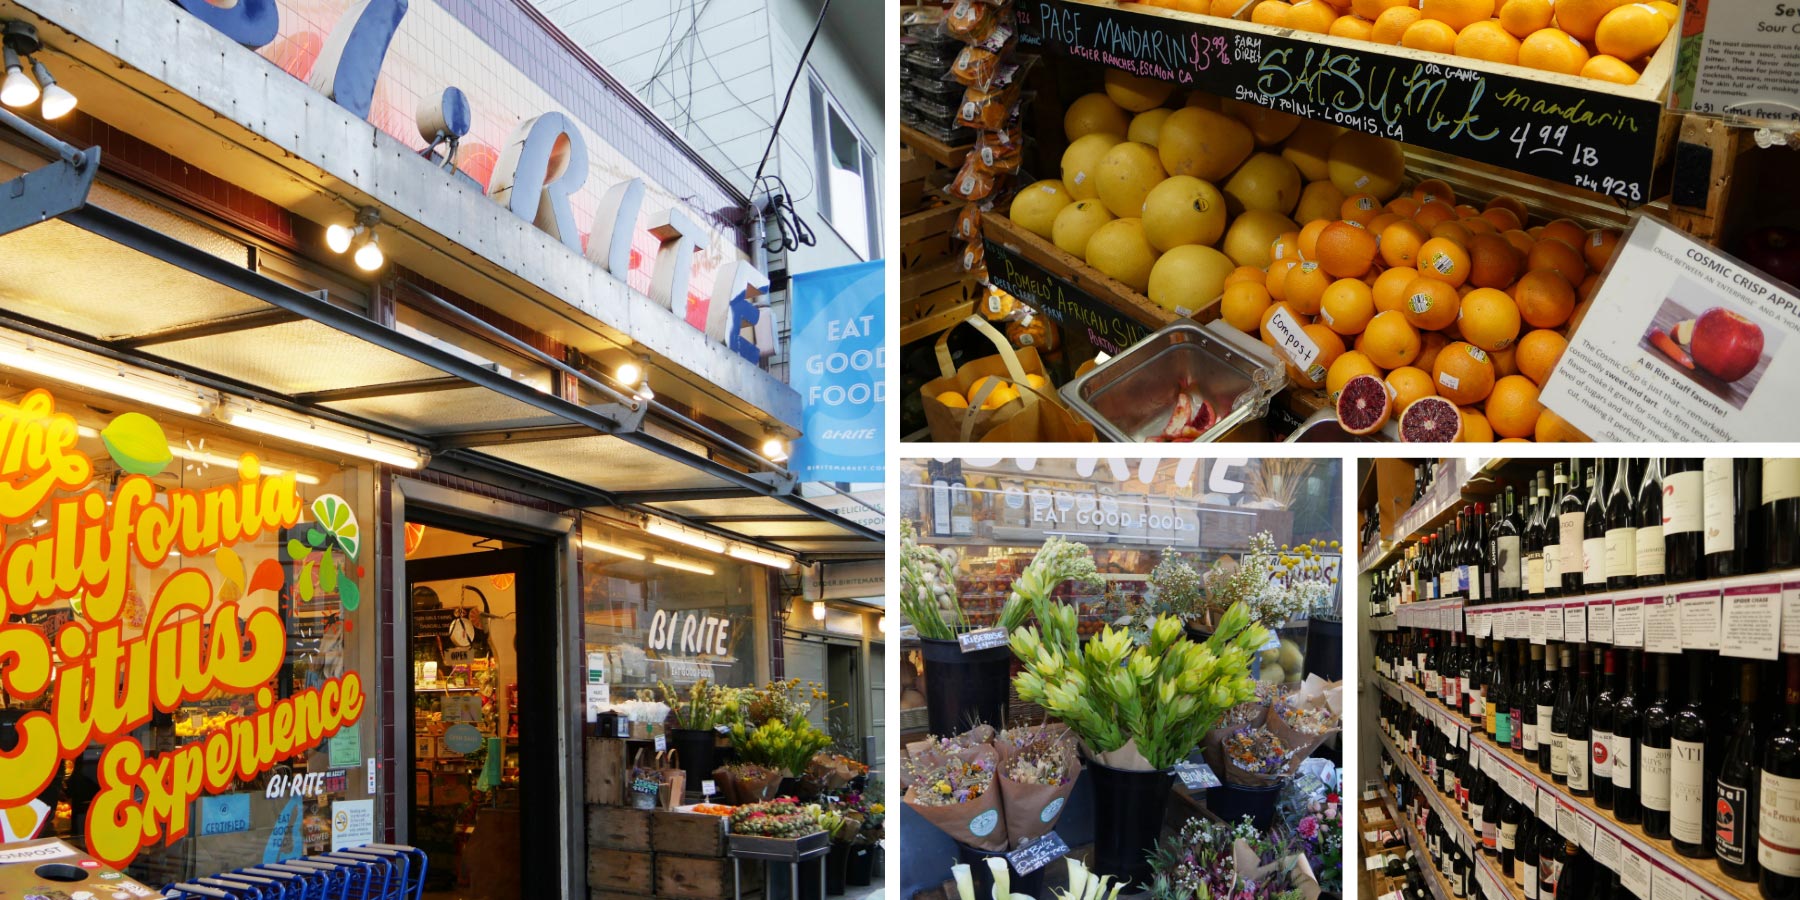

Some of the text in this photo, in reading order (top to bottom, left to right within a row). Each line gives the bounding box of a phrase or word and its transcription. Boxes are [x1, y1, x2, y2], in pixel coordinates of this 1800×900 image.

[1040, 3, 1082, 48] PAGE
[1093, 17, 1187, 71] MANDARIN
[1235, 35, 1262, 49] FARM
[1757, 21, 1787, 33] Sour
[1102, 50, 1140, 77] RANCHES,
[1178, 70, 1194, 84] CA
[1723, 48, 1745, 56] flavor
[1731, 65, 1754, 73] choice
[1756, 66, 1768, 74] for
[1768, 68, 1792, 77] juicing
[1732, 57, 1752, 65] These
[1257, 47, 1638, 141] SATSUMA mandarin
[1694, 102, 1782, 119] 631 Citrus Press
[1771, 85, 1799, 95] making
[1387, 124, 1404, 141] CA
[1602, 176, 1641, 201] 928
[1653, 246, 1674, 262] CROSS
[1674, 257, 1704, 279] BETWEEN
[1704, 275, 1716, 284] AN
[1758, 305, 1776, 318] AND
[1686, 248, 1732, 279] COSMIC
[1732, 273, 1767, 297] CRISP
[827, 315, 875, 342] EAT
[1058, 286, 1109, 336] AFRICAN
[1272, 313, 1312, 361] Compost
[1558, 366, 1576, 381] level
[1575, 378, 1585, 388] of
[1583, 385, 1607, 405] sugars
[1607, 399, 1623, 415] and
[1622, 411, 1647, 432] acidity
[1567, 358, 1588, 376] flavor
[1588, 372, 1608, 389] make
[1608, 385, 1614, 394] it
[1613, 390, 1634, 408] great
[1634, 402, 1646, 415] for
[1646, 413, 1681, 440] snacking
[1569, 346, 1606, 374] cosmically
[1604, 370, 1628, 389] sweet
[1627, 384, 1643, 398] and
[1662, 407, 1673, 419] Its
[1673, 414, 1690, 430] firm
[1582, 339, 1732, 443] The Cosmic Crisp is just that remarkably
[1637, 357, 1728, 419] A Bi Rite Staff favorite!
[1567, 388, 1581, 402] cut,
[1581, 397, 1609, 421] making
[1613, 420, 1642, 443] perfect
[0, 388, 92, 523] The
[0, 453, 302, 622] alifornia
[1033, 506, 1185, 531] EAT GOOD FOOD
[648, 609, 730, 655] BI RITE
[0, 567, 285, 807] Citrus
[671, 666, 681, 677] EAT
[84, 670, 366, 870] Experience
[205, 818, 246, 834] CERTIFIED
[277, 813, 290, 824] EAT
[0, 846, 62, 860] OMPOST
